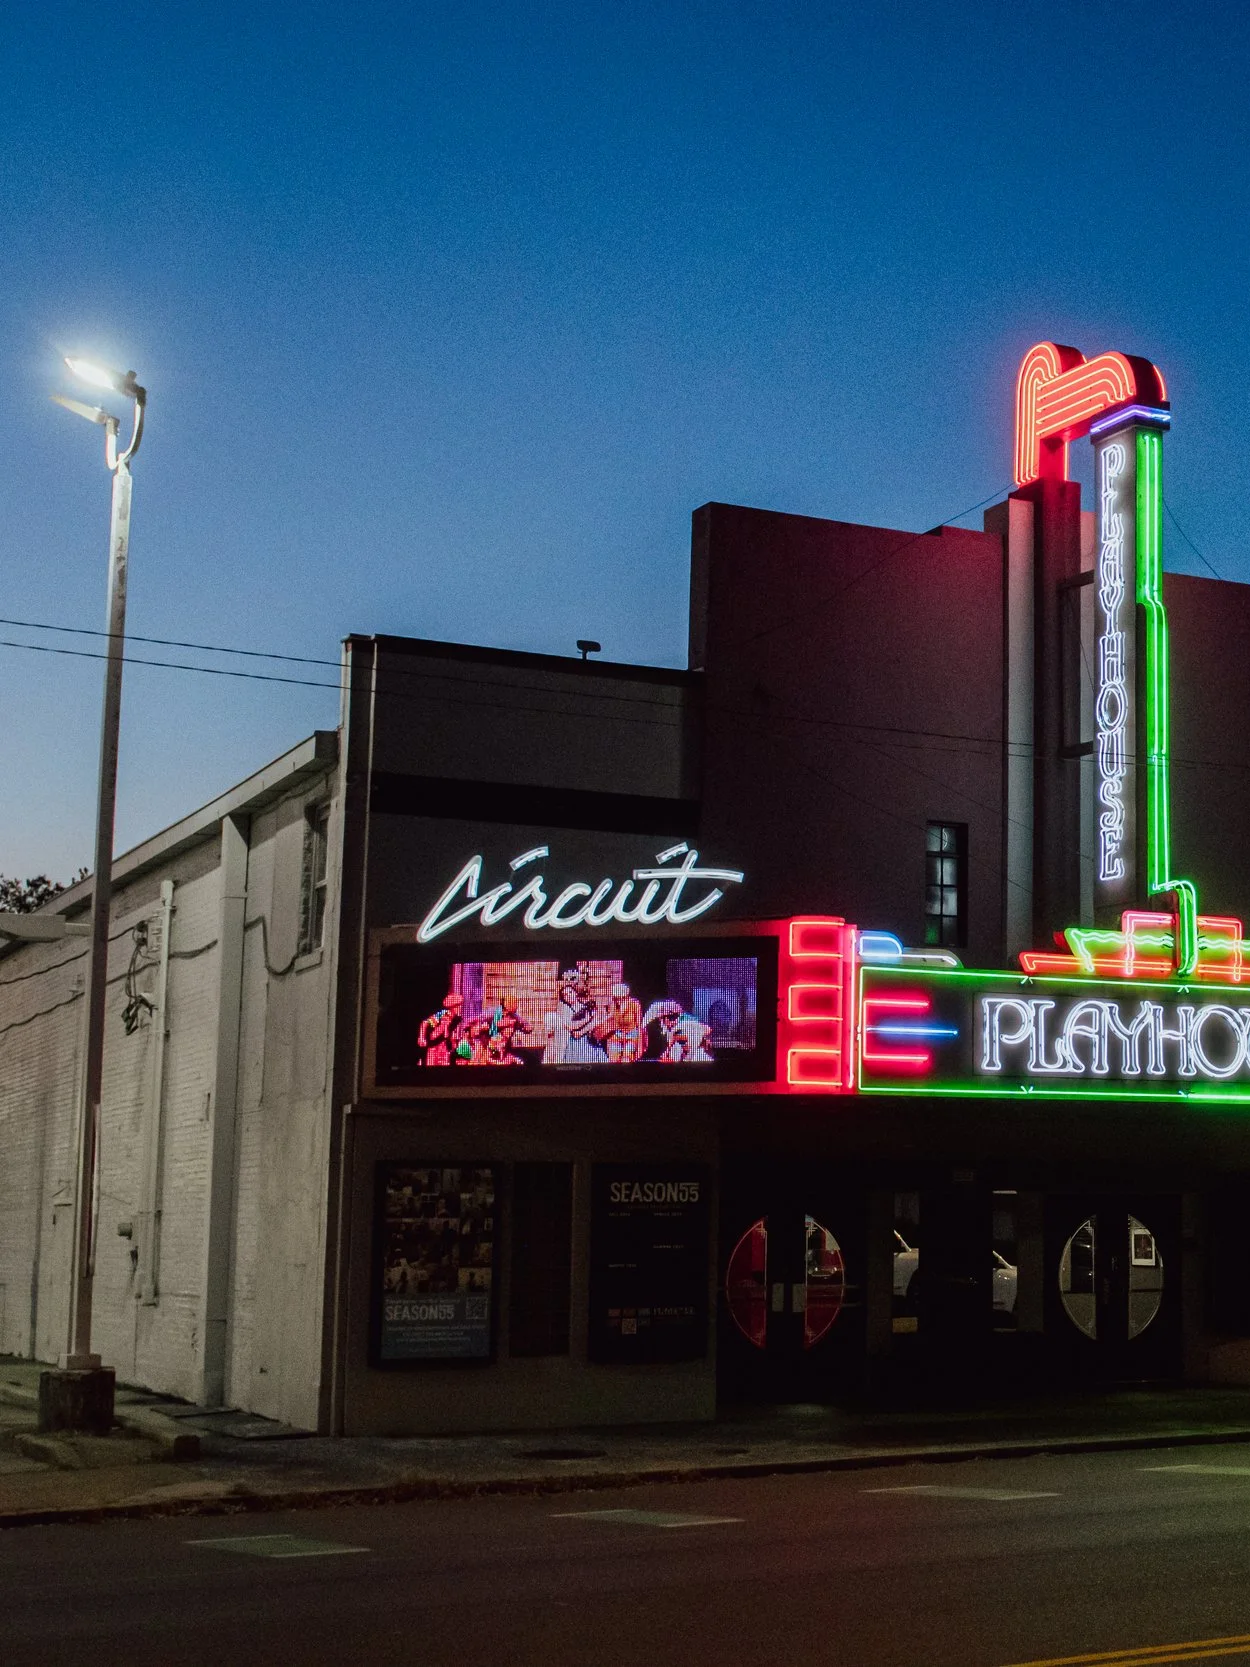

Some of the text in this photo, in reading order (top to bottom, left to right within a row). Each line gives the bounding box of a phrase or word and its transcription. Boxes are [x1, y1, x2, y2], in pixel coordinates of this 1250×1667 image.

[1096, 443, 1129, 880] PLAYHOUSE
[416, 841, 744, 943] Circuit
[609, 1181, 700, 1202] SEASON55
